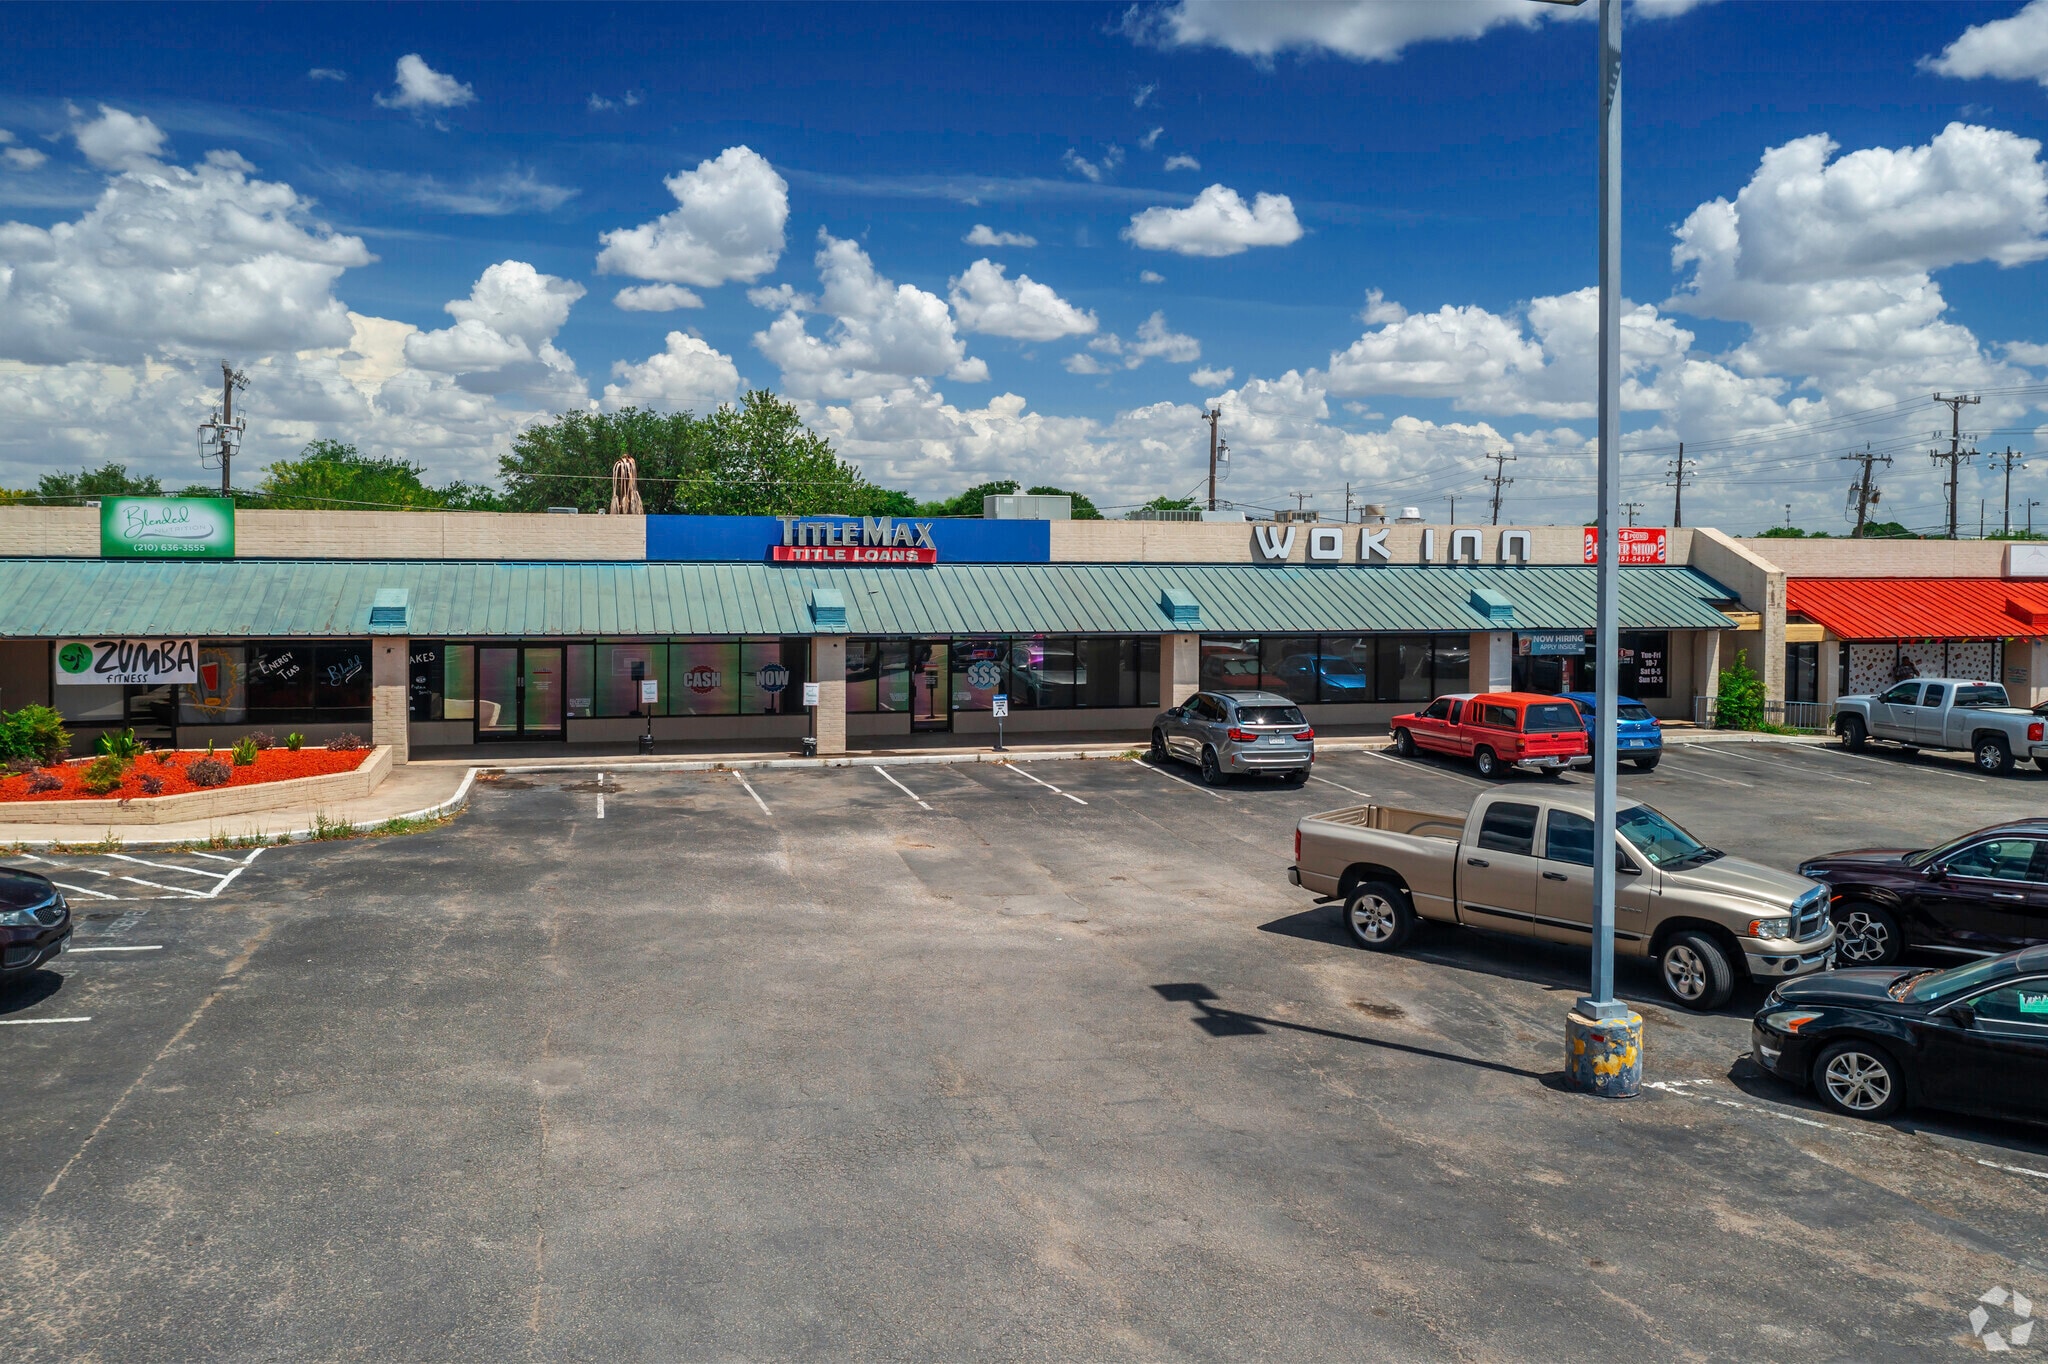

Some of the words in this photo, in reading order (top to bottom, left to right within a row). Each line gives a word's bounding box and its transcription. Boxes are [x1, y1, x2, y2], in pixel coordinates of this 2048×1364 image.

[123, 505, 191, 539] Blended
[154, 524, 207, 534] NUTRITION
[133, 544, 158, 552] (210)
[160, 544, 206, 552] 636-3555
[1255, 526, 1392, 560] WOK
[792, 549, 846, 560] TITLE
[854, 549, 919, 561] LOANS
[1631, 543, 1657, 556] SHOP
[1533, 635, 1554, 643] NOW
[93, 639, 195, 675] ZUMBA
[409, 651, 436, 664] AKES
[1640, 667, 1651, 675] Sat
[106, 674, 148, 683] FITNESS
[683, 671, 722, 688] CASH
[755, 670, 790, 687] NOW
[1638, 675, 1651, 683] Sun
